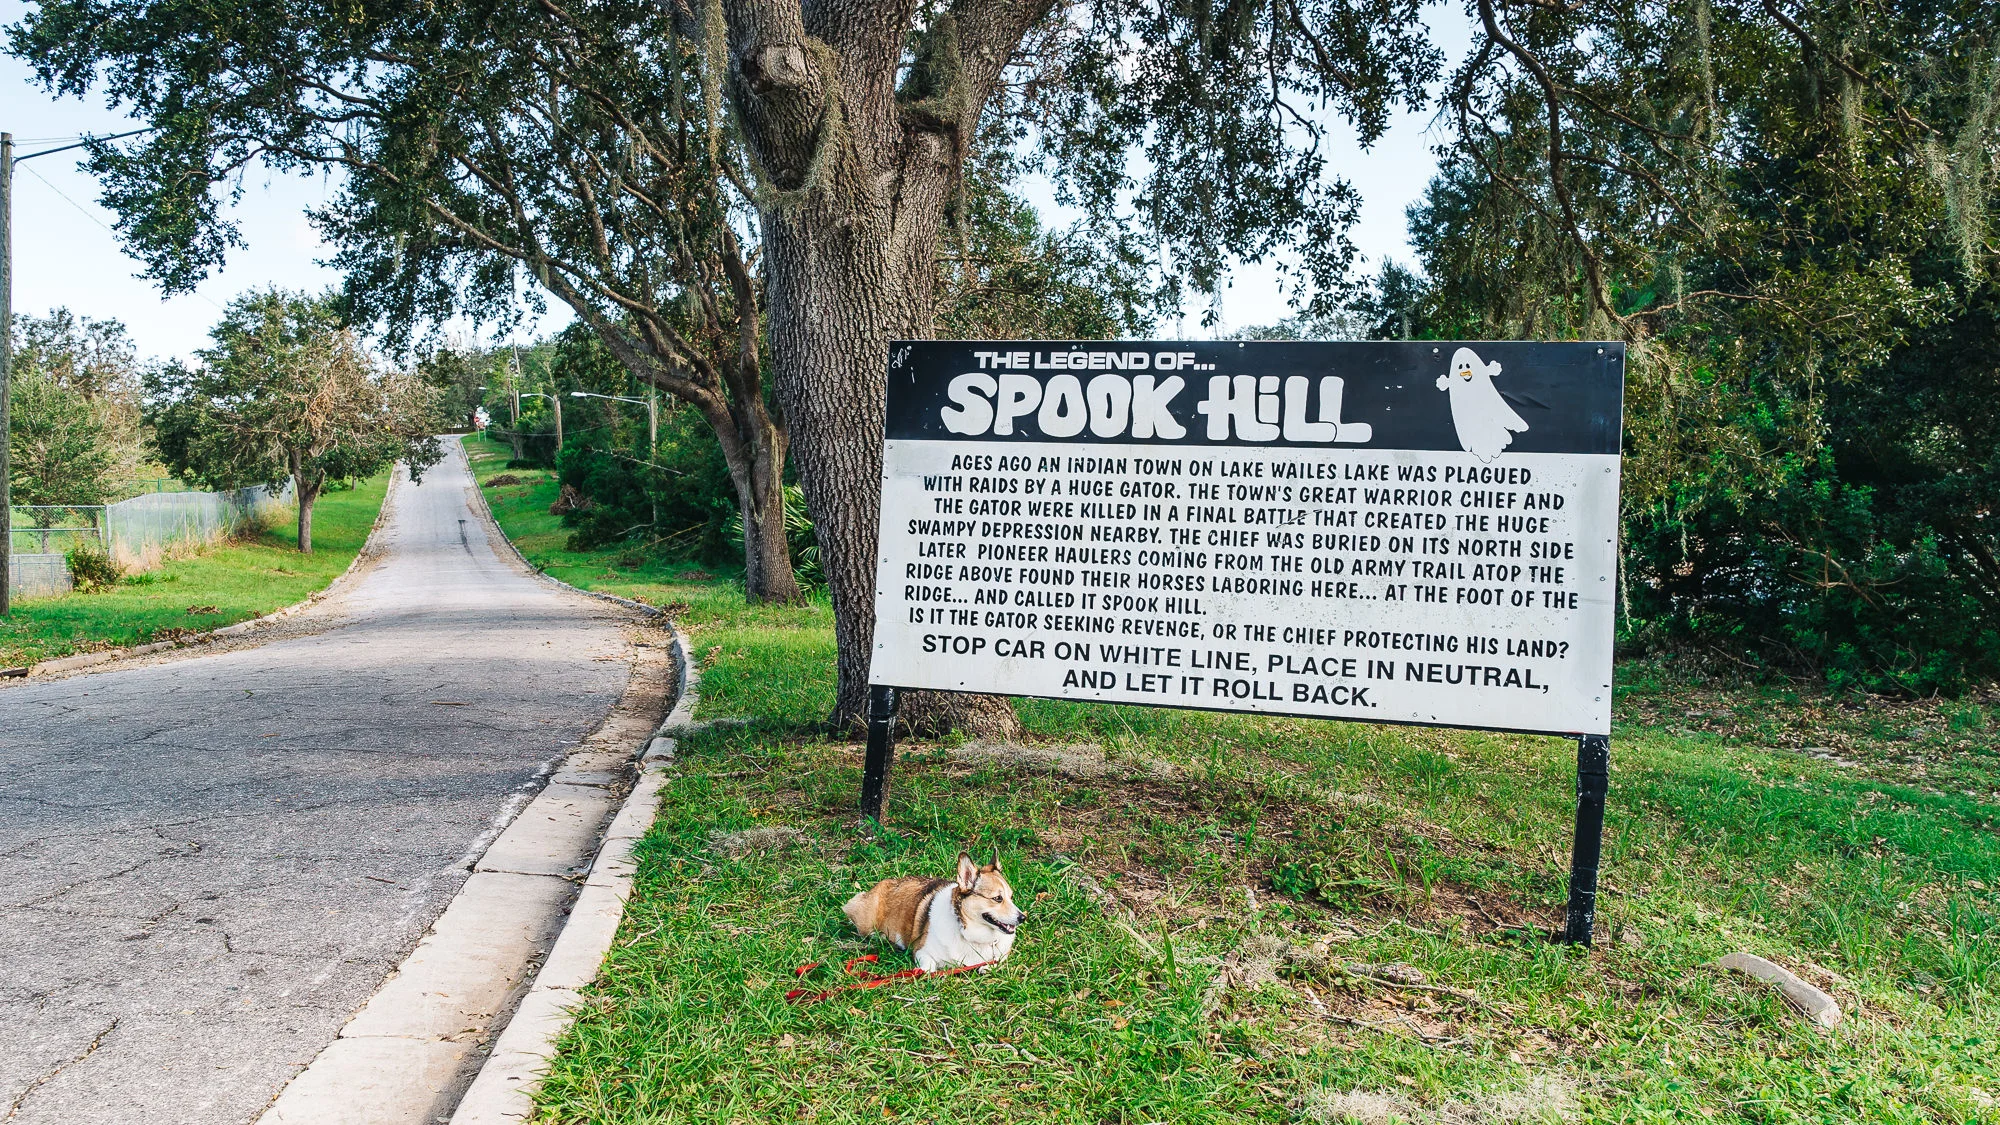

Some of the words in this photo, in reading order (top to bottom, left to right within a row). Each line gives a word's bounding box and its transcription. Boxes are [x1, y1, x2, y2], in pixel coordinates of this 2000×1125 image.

[973, 351, 1031, 370] THE
[1033, 351, 1150, 370] LEGEND
[1154, 351, 1216, 371] OF...
[940, 373, 1187, 439] SPOOK
[951, 454, 993, 471] AGES
[998, 455, 1032, 472] AGO
[1037, 456, 1061, 473] AN
[1067, 456, 1127, 475] INDIAN
[1133, 458, 1182, 476] TOWN
[1189, 460, 1213, 477] ON
[1221, 460, 1264, 478] LAKE
[1271, 462, 1337, 480] WAILES
[1344, 463, 1390, 481] LAKE
[1397, 465, 1437, 483] WAS
[1445, 466, 1531, 485] PLAGUED
[923, 475, 963, 492] WITH
[969, 476, 1018, 494] RAIDS
[1024, 478, 1046, 495] BY
[1050, 479, 1061, 496] A
[1068, 479, 1114, 497] HUGE
[1119, 481, 1181, 499] GATOR.
[1188, 482, 1220, 500] THE
[1226, 484, 1293, 502] TOWN'S
[1299, 486, 1357, 505] GREAT
[1364, 488, 1452, 507] WARRIOR
[1460, 490, 1517, 509] CHIEF
[1523, 492, 1564, 511] AND
[934, 497, 963, 515] THE
[969, 498, 1022, 517] GATOR
[1028, 500, 1074, 518] WERE
[1080, 502, 1137, 520] KILLED
[1143, 504, 1161, 521] IN
[1167, 505, 1179, 522] A
[1186, 505, 1237, 524] FINAL
[1243, 507, 1308, 526] BATTLE
[1312, 509, 1358, 528] THAT
[1364, 511, 1447, 531] CREATED
[1454, 514, 1489, 532] THE
[1497, 514, 1549, 534] HUGE
[907, 519, 977, 537] SWAMPY
[981, 521, 1083, 541] DEPRESSION
[1090, 525, 1162, 544] NEARBY.
[1169, 528, 1201, 546] THE
[1207, 529, 1260, 548] CHIEF
[1266, 532, 1304, 549] WAS
[1312, 533, 1381, 552] BURIED
[1388, 536, 1414, 554] ON
[1422, 537, 1450, 555] ITS
[1457, 538, 1522, 558] NORTH
[1529, 541, 1574, 560] SIDE
[919, 541, 966, 559] LATER
[977, 543, 1049, 562] PIONEER
[1055, 546, 1131, 566] HAULERS
[1138, 550, 1207, 569] COMING
[1214, 553, 1263, 571] FROM
[1270, 555, 1303, 573] THE
[1310, 557, 1345, 575] OLD
[1351, 559, 1406, 577] ARMY
[1412, 560, 1466, 580] TRAIL
[1472, 563, 1522, 583] ATOP
[1528, 565, 1565, 584] THE
[904, 584, 968, 604] RIDGE...
[974, 588, 1008, 606] AND
[1014, 590, 1075, 608] CALLED
[1081, 592, 1097, 610] IT
[1101, 594, 1159, 613] SPOOK
[1165, 597, 1207, 616] HILL.
[905, 562, 953, 581] RIDGE
[958, 565, 1013, 583] ABOVE
[1019, 568, 1075, 586] FOUND
[1081, 570, 1131, 589] THEIR
[1137, 572, 1205, 592] HORSES
[1212, 576, 1303, 597] LABORING
[1311, 580, 1377, 600] HERE...
[1384, 583, 1408, 602] AT
[1413, 585, 1448, 603] THE
[1456, 587, 1505, 606] FOOT
[1511, 589, 1535, 608] OF
[1542, 590, 1579, 610] THE
[909, 607, 924, 624] IS
[930, 608, 945, 625] IT
[949, 609, 979, 627] THE
[984, 611, 1038, 630] GATOR
[1043, 614, 1115, 634] SEEKING
[1122, 618, 1205, 641] REVENGE,
[1212, 623, 1237, 641] OR
[1243, 624, 1276, 643] THE
[1282, 626, 1336, 646] CHIEF
[1343, 630, 1459, 653] PROTECTING
[1466, 636, 1499, 655] HIS
[1507, 638, 1569, 659] LAND?
[922, 634, 987, 655] STOP
[994, 638, 1045, 659] CAR
[1054, 641, 1091, 662] ON
[1099, 644, 1181, 667] WHITE
[1191, 649, 1257, 676] LINE,
[1267, 654, 1357, 678] PLACE
[1367, 659, 1395, 680] IN
[1405, 662, 1549, 694] NEUTRAL,
[1062, 669, 1116, 690] AND
[1126, 672, 1173, 693] LET
[1181, 676, 1204, 695] IT
[1212, 678, 1283, 701] ROLL
[1292, 683, 1377, 708] BACK.
